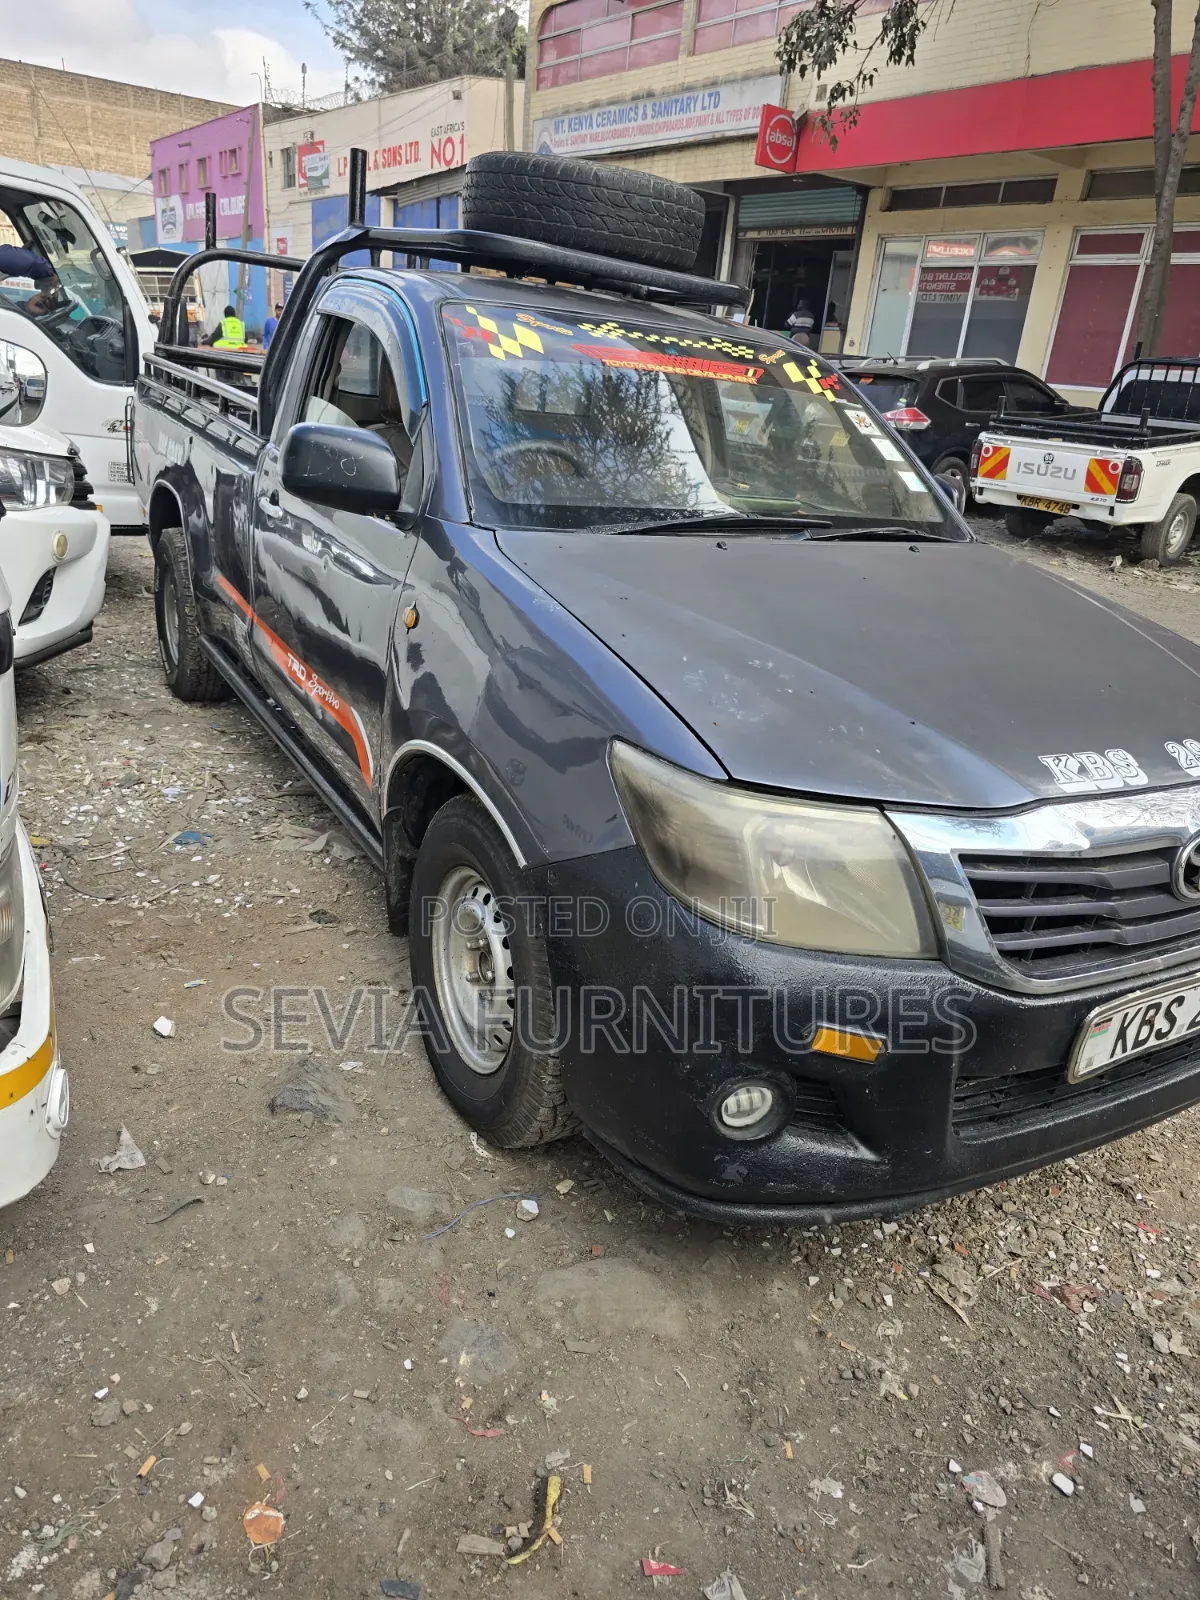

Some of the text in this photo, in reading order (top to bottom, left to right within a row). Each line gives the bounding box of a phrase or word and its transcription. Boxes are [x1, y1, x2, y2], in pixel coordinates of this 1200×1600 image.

[554, 91, 721, 136] MT. KENYA CERAMICS & SANITARY LTD
[715, 111, 725, 125] ALL
[726, 109, 743, 123] TYPES
[744, 107, 751, 120] OF
[430, 121, 465, 137] EAST AFRICA'S
[769, 128, 793, 147] absa
[373, 149, 379, 170] &
[382, 144, 402, 169] SONS
[405, 140, 421, 165] LTD.
[430, 133, 465, 170] NO.1
[602, 358, 646, 371] TOYOTA
[646, 364, 687, 376] RACING
[1016, 461, 1077, 481] ISUZU
[1021, 495, 1042, 508] KBR
[287, 652, 307, 681] TRD
[1038, 748, 1149, 793] KBS
[1110, 995, 1186, 1059] KBS
